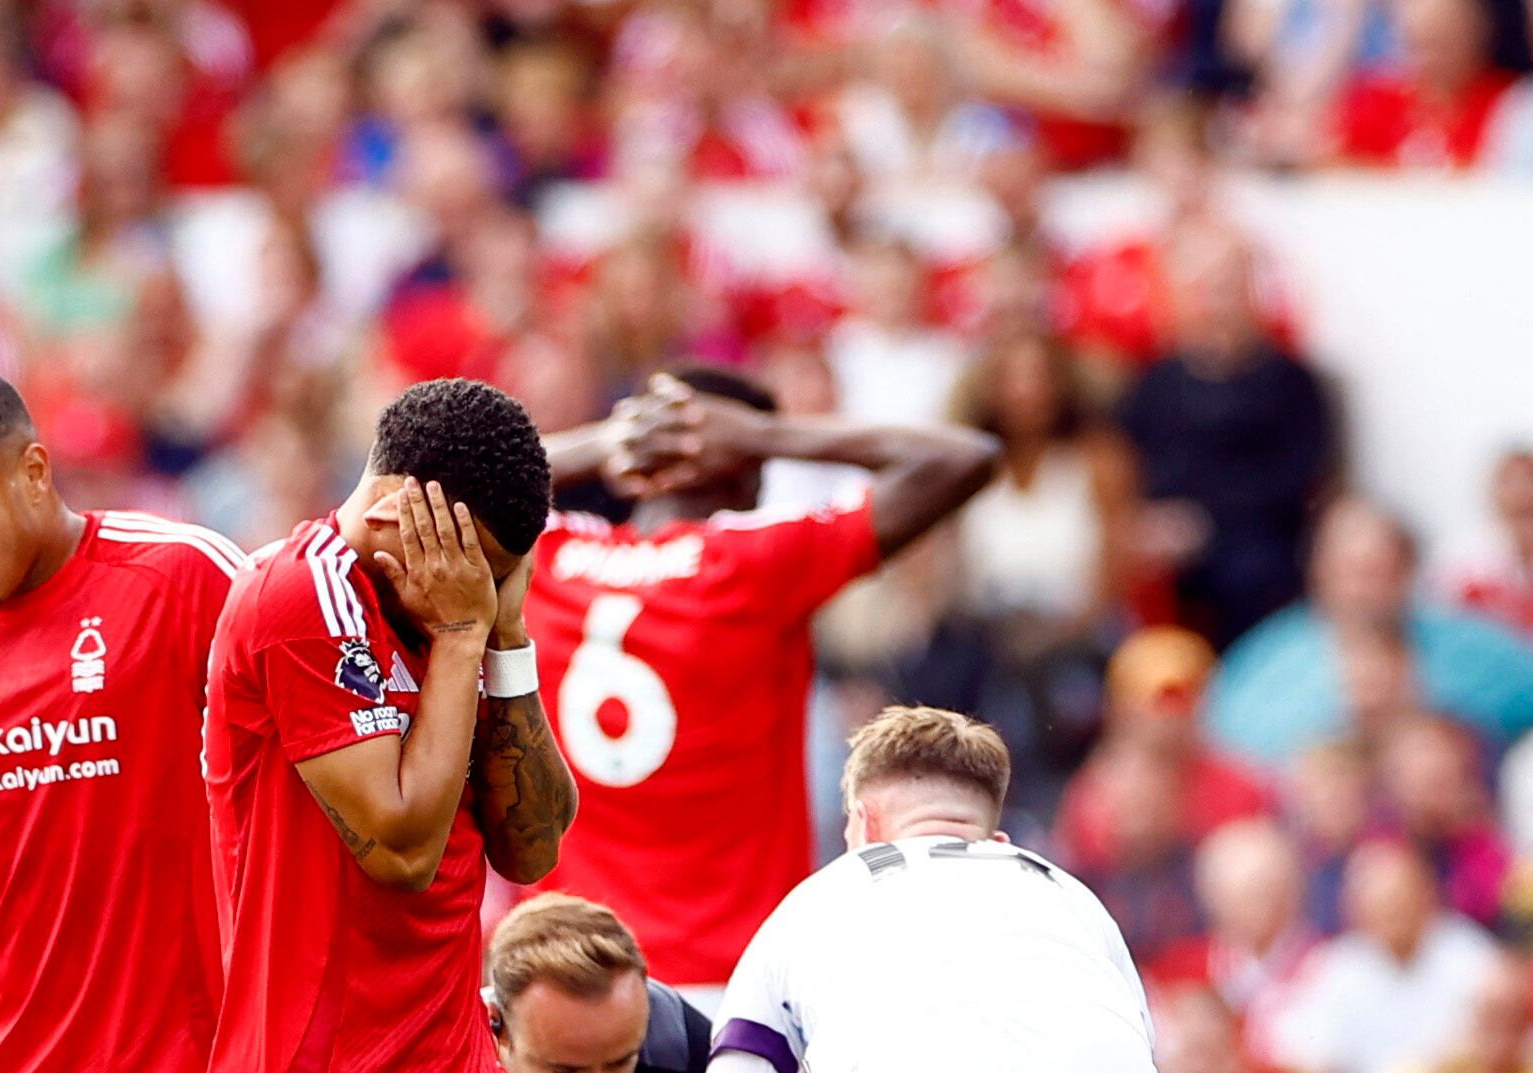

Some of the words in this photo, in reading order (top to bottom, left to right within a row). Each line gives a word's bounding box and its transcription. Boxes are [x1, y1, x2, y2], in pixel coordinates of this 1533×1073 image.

[350, 709, 373, 724] No
[373, 706, 398, 719] room
[558, 592, 677, 788] 6
